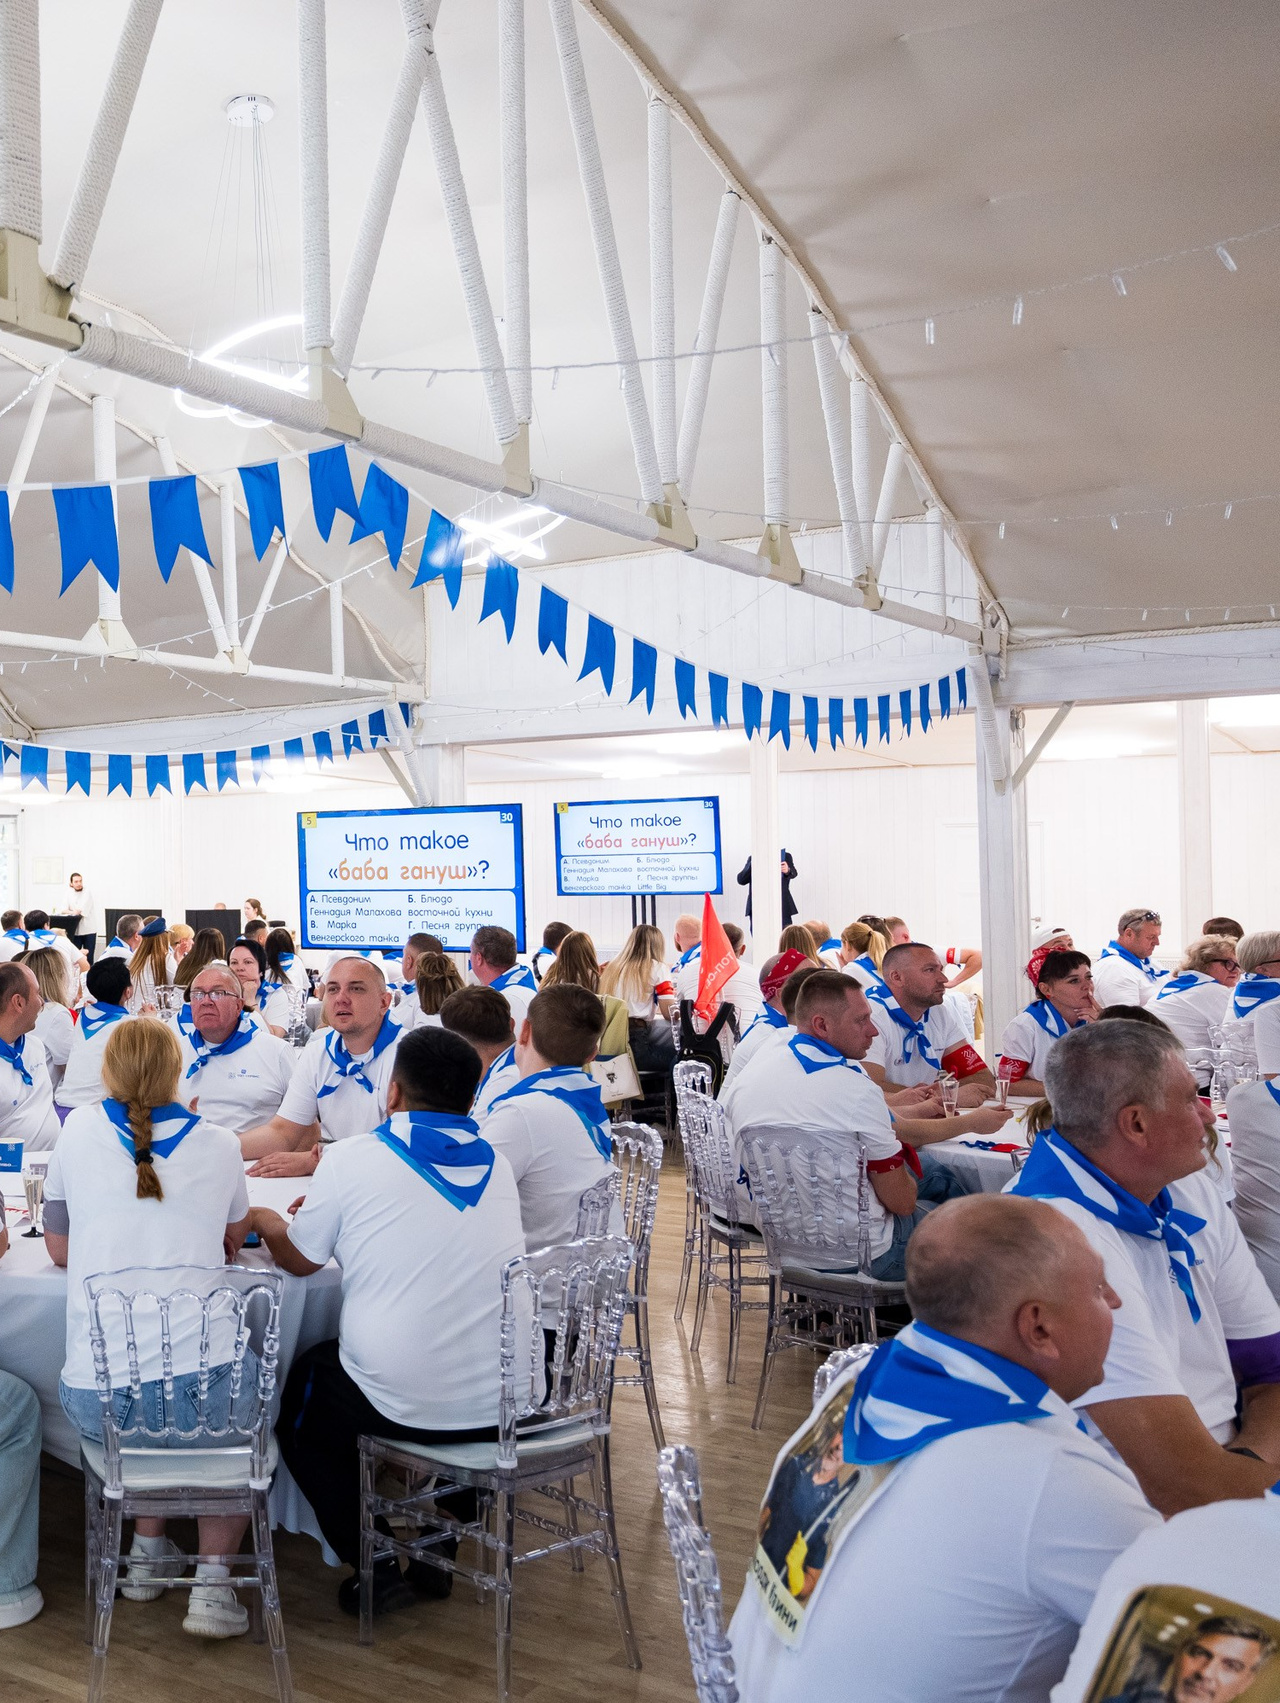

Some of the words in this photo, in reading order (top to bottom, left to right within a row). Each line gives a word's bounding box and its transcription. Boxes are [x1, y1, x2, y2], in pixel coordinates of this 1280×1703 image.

[306, 817, 312, 826] 5
[501, 812, 513, 823] 30
[589, 816, 622, 828] Что
[630, 814, 682, 827] такое
[345, 833, 389, 851] Что
[400, 830, 470, 850] такое
[577, 833, 622, 849] «баба
[631, 833, 697, 850] гануш»?
[572, 858, 610, 866] Псевдоним
[646, 856, 670, 864] Блюдо
[328, 857, 389, 881] «баба
[400, 860, 490, 885] гануш»?
[637, 865, 676, 873] восточной
[678, 865, 700, 873] кухни
[576, 875, 600, 883] Марка
[655, 883, 667, 892] Big
[309, 895, 318, 903] А.
[321, 895, 372, 906] Псевдоним
[407, 894, 416, 904] Б.
[421, 894, 453, 906] Блюдо
[309, 907, 351, 918] Геннадия
[355, 908, 402, 917] Малахова
[407, 907, 461, 917] восточной
[465, 907, 493, 919] кухни
[310, 920, 318, 929] В.
[327, 920, 357, 931] Марка
[408, 920, 416, 930] Г.
[421, 920, 450, 930] Песня
[310, 933, 365, 943] венгерского
[368, 934, 400, 943] танка
